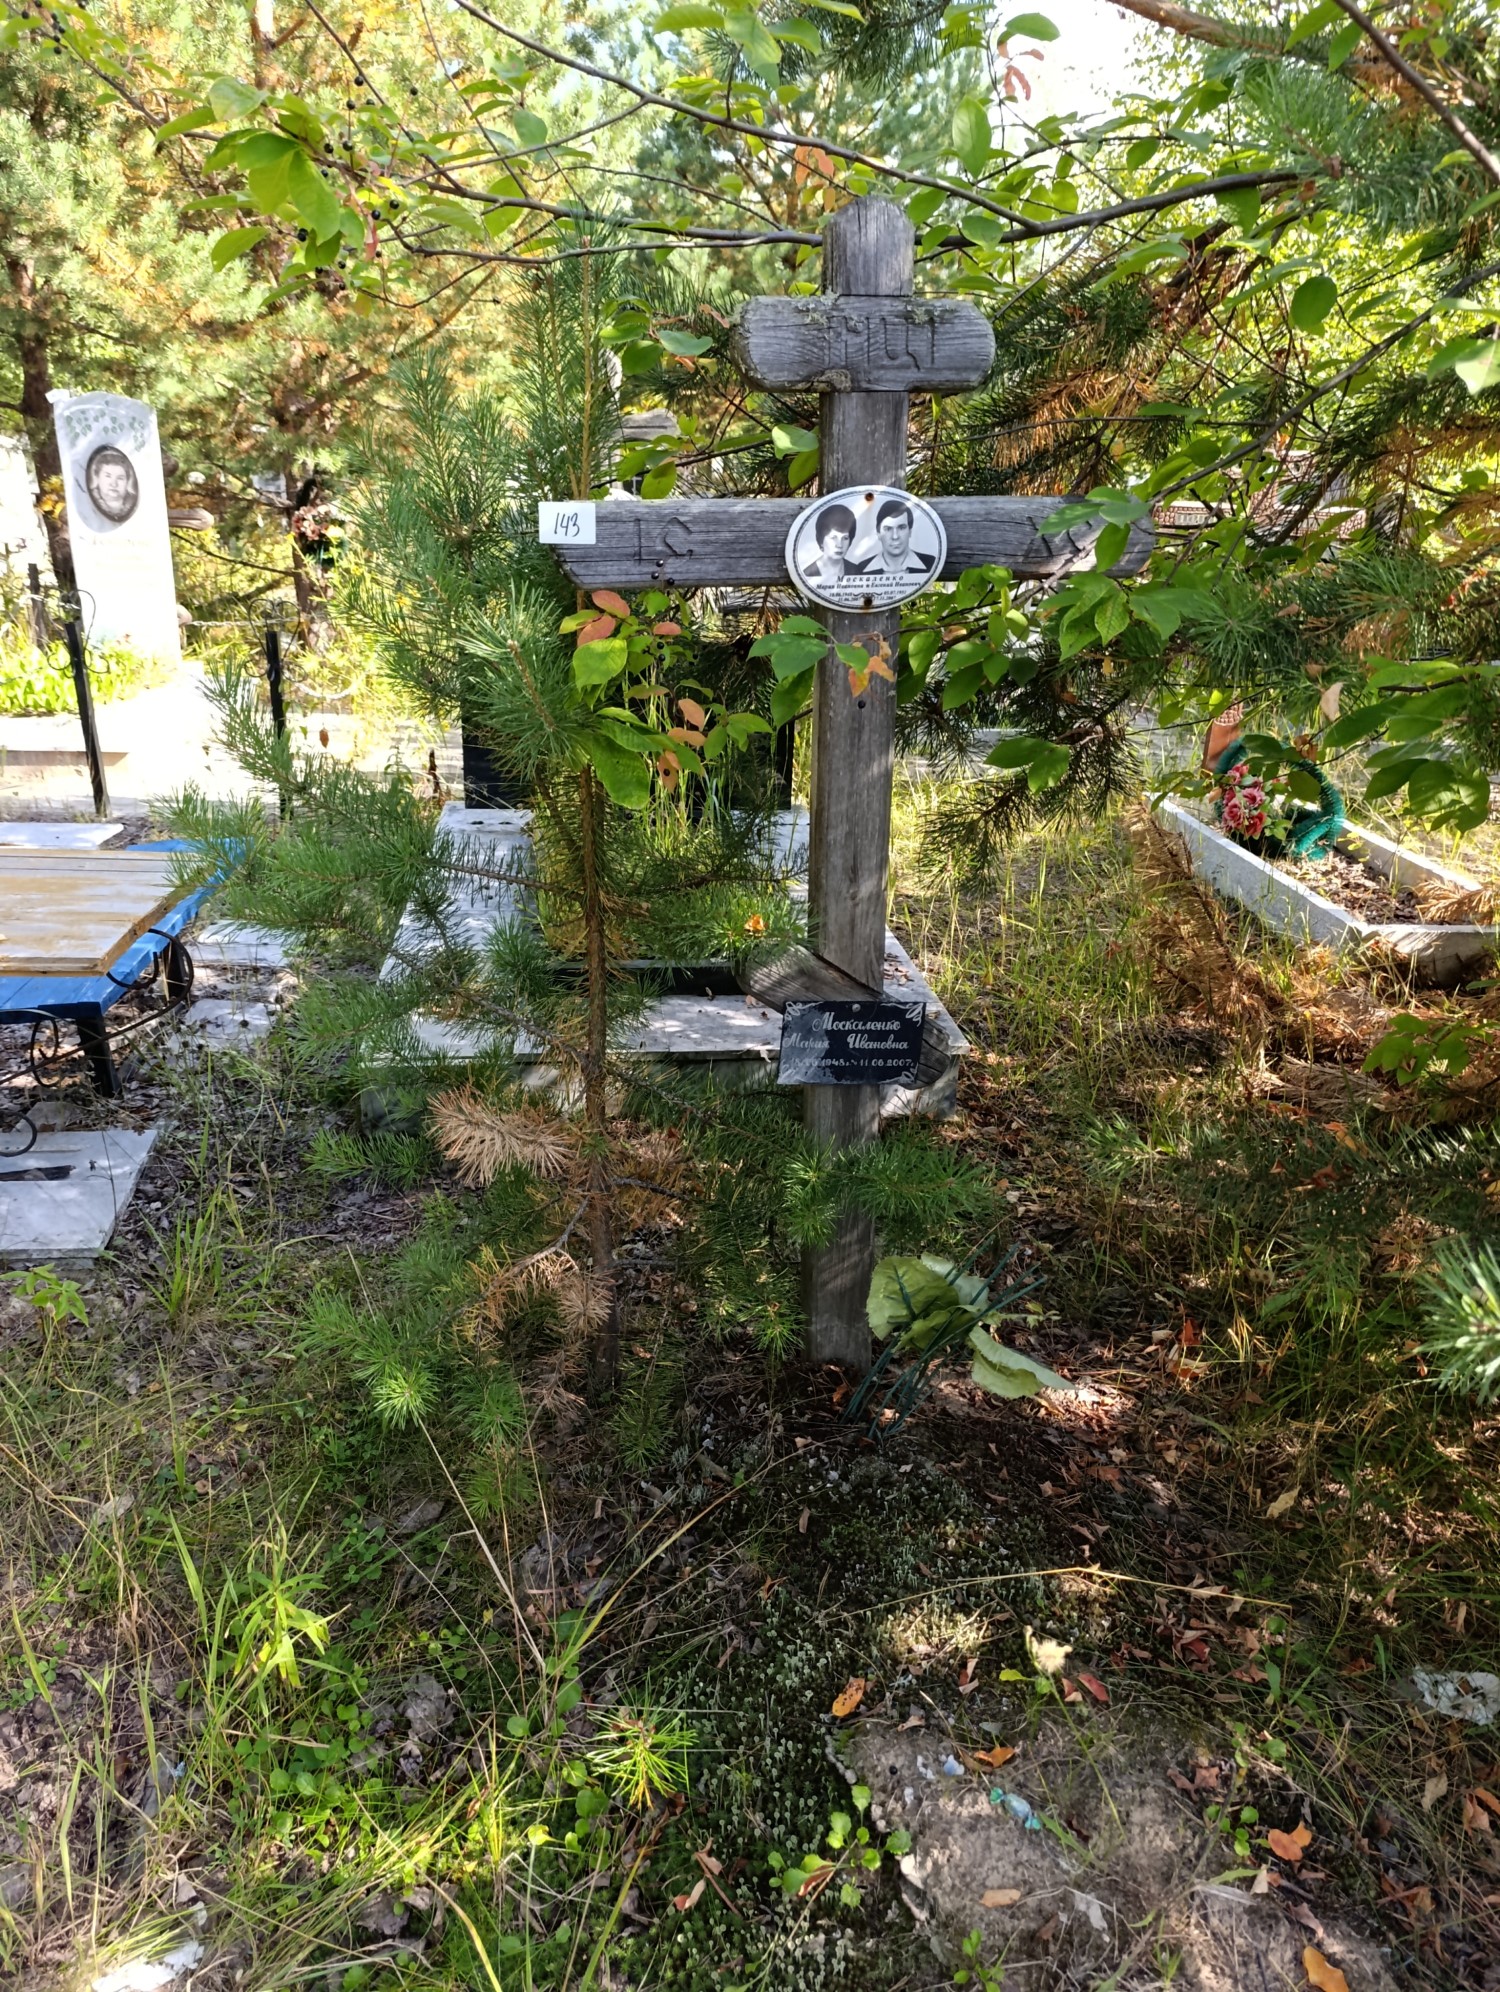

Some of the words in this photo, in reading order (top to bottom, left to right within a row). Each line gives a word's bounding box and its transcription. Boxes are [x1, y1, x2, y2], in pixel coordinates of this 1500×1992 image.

[553, 511, 581, 538] 143
[836, 575, 905, 583] Москаленко
[811, 1011, 902, 1031] Москаленко
[782, 1033, 831, 1052] Мария
[846, 1033, 910, 1050] Ивановна
